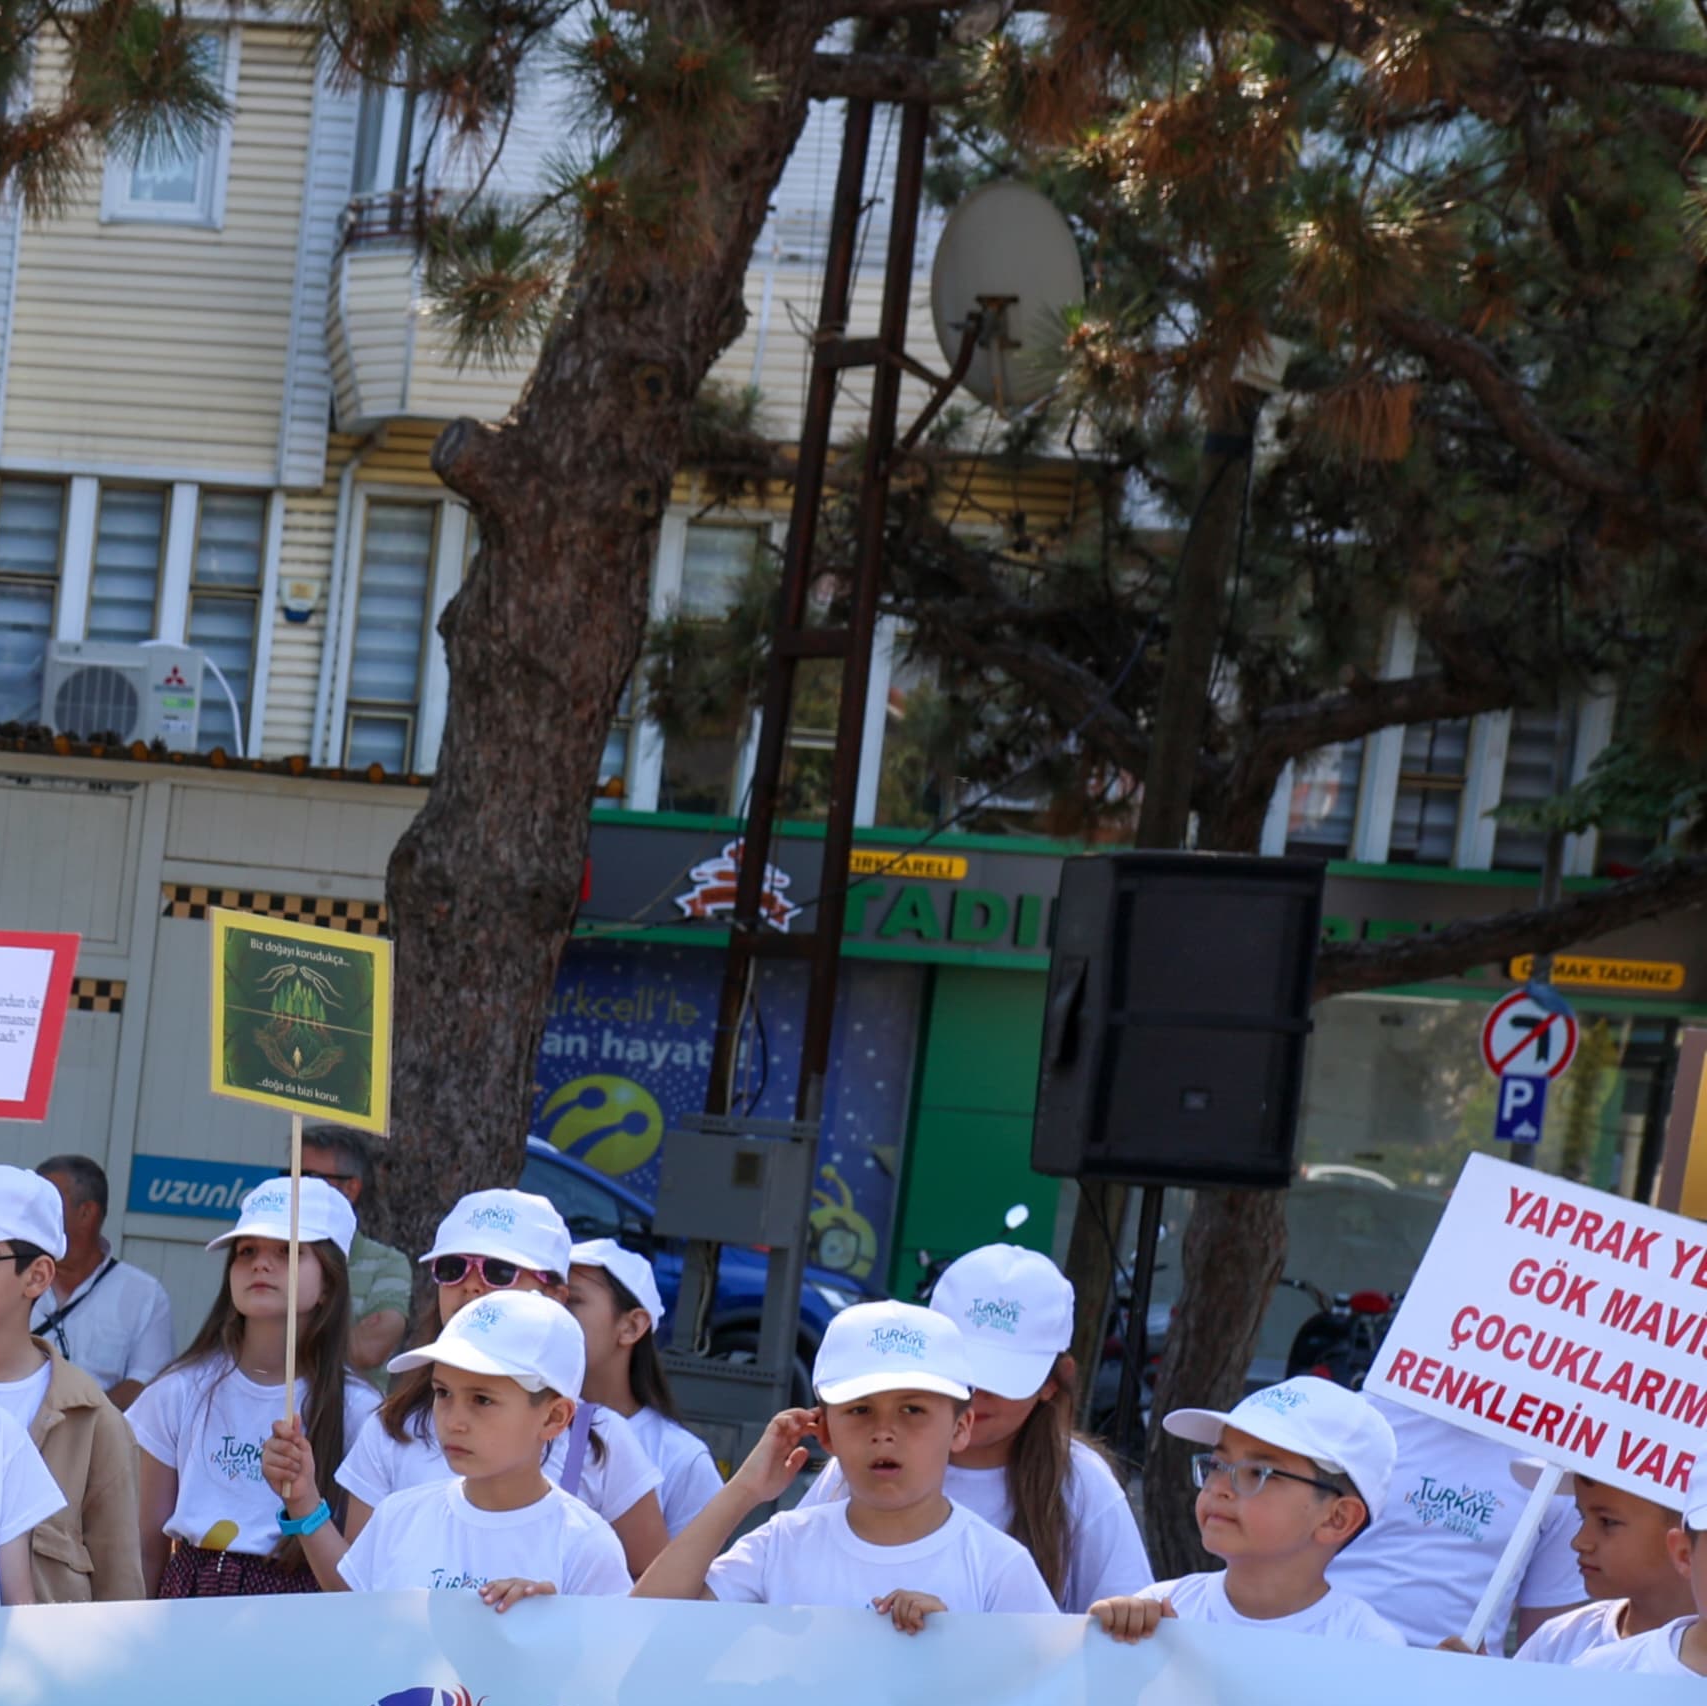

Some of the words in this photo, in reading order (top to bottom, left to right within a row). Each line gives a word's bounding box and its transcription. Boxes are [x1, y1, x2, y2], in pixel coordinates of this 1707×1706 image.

[843, 881, 1043, 948] TADI
[250, 938, 264, 950] Biz
[265, 940, 295, 958] doğayı
[544, 982, 698, 1026] urkcell'le
[285, 1082, 296, 1094] da
[297, 1085, 313, 1097] bizi
[1502, 1079, 1534, 1121] P
[148, 1177, 254, 1209] uzunl
[1504, 1186, 1663, 1270] YAPRAK
[1508, 1258, 1599, 1318] GÖK
[1386, 1347, 1609, 1458] RENKLERİN
